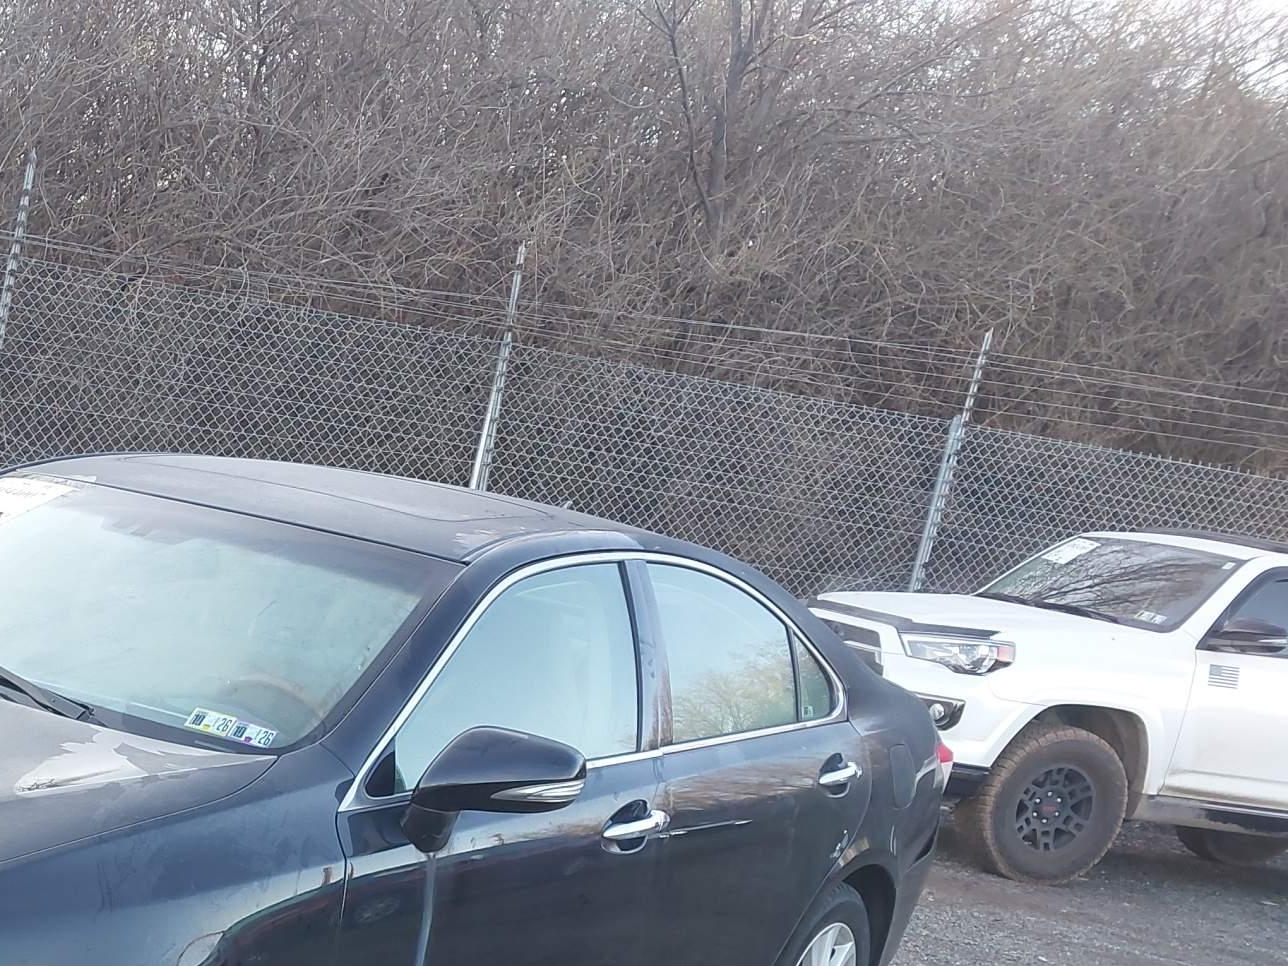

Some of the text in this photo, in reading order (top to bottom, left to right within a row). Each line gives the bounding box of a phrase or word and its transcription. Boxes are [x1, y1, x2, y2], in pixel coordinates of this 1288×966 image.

[191, 714, 232, 732] 10 26
[233, 726, 273, 745] 10 26
